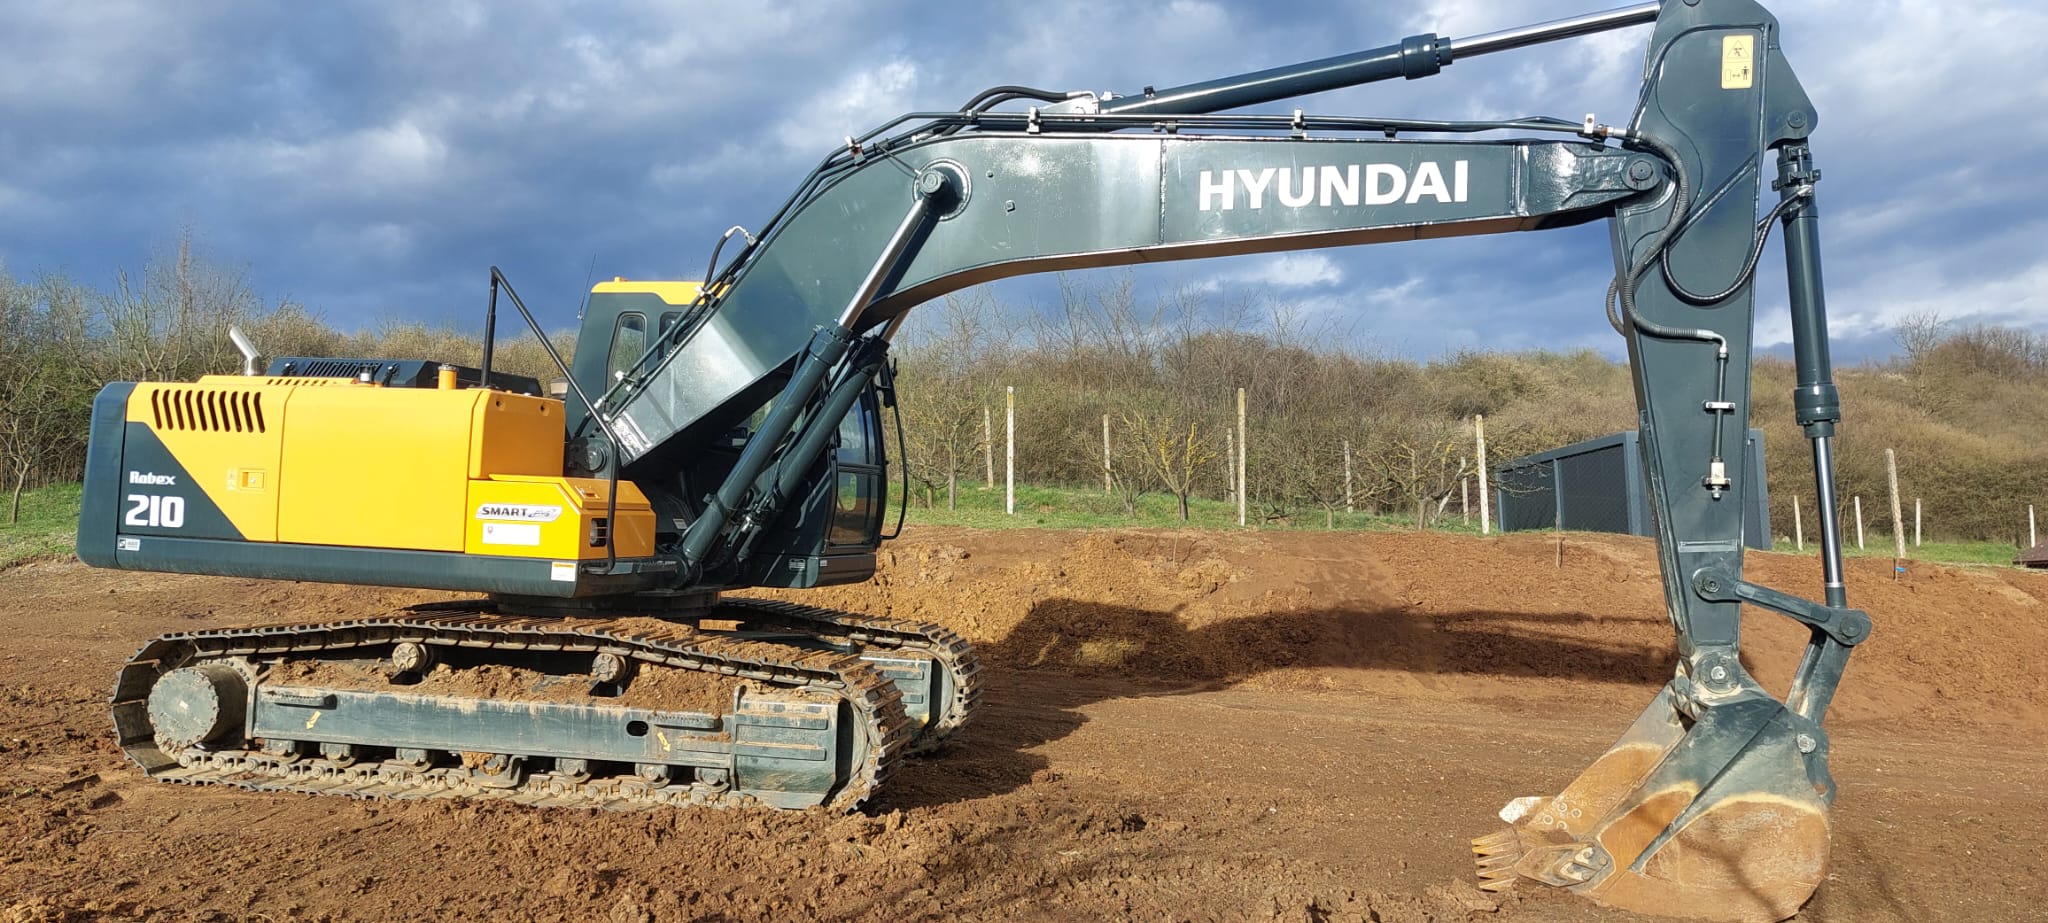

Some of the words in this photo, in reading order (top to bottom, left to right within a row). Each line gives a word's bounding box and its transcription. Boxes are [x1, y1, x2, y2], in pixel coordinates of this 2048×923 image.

[1199, 160, 1469, 211] HYUNDAI
[125, 494, 185, 528] 210
[481, 506, 528, 517] SMART
